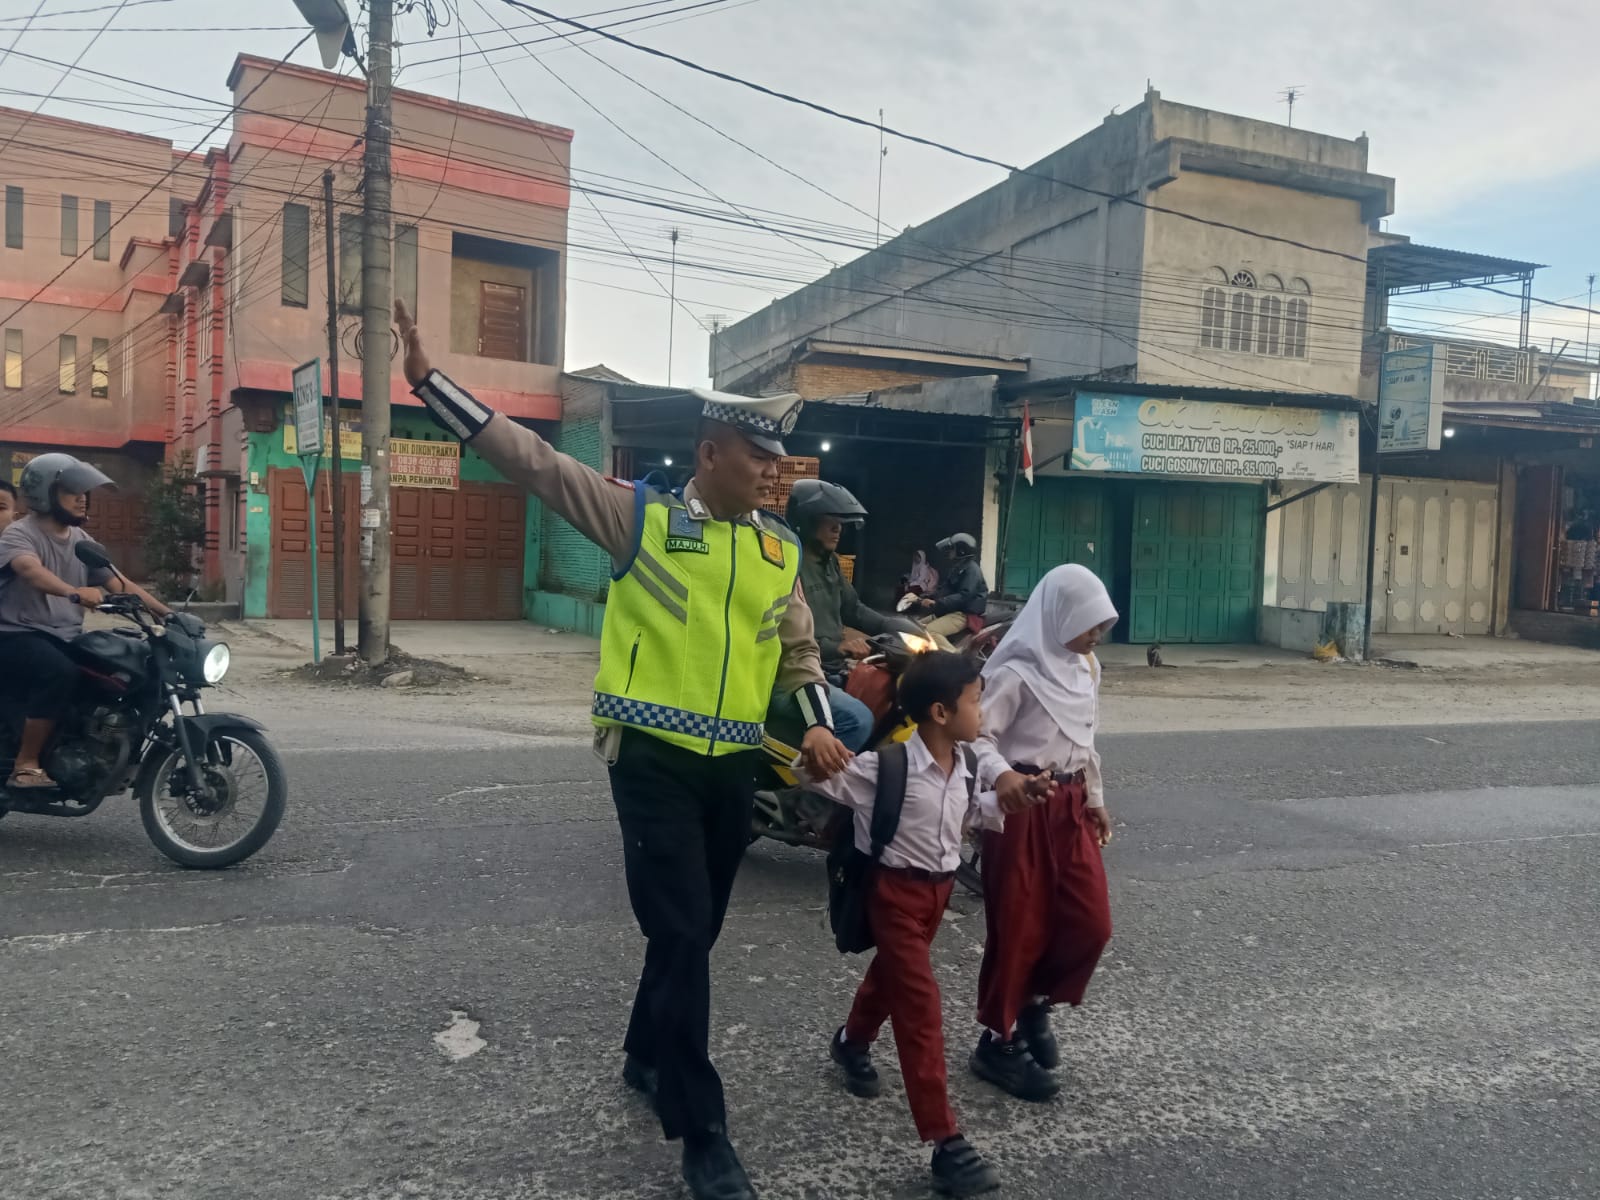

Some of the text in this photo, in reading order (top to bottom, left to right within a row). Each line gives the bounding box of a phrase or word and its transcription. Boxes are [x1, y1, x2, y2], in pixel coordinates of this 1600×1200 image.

[1142, 433, 1166, 452] CUCI
[1167, 434, 1197, 453] LIPAT
[1196, 436, 1206, 452] 7
[1205, 436, 1220, 453] KG
[1315, 441, 1335, 451] HARI
[1141, 455, 1165, 473] CUCI
[1167, 456, 1202, 473] GOSOK
[1200, 459, 1209, 473] 7
[1208, 459, 1223, 474] KG
[409, 475, 452, 486] PERANTARA
